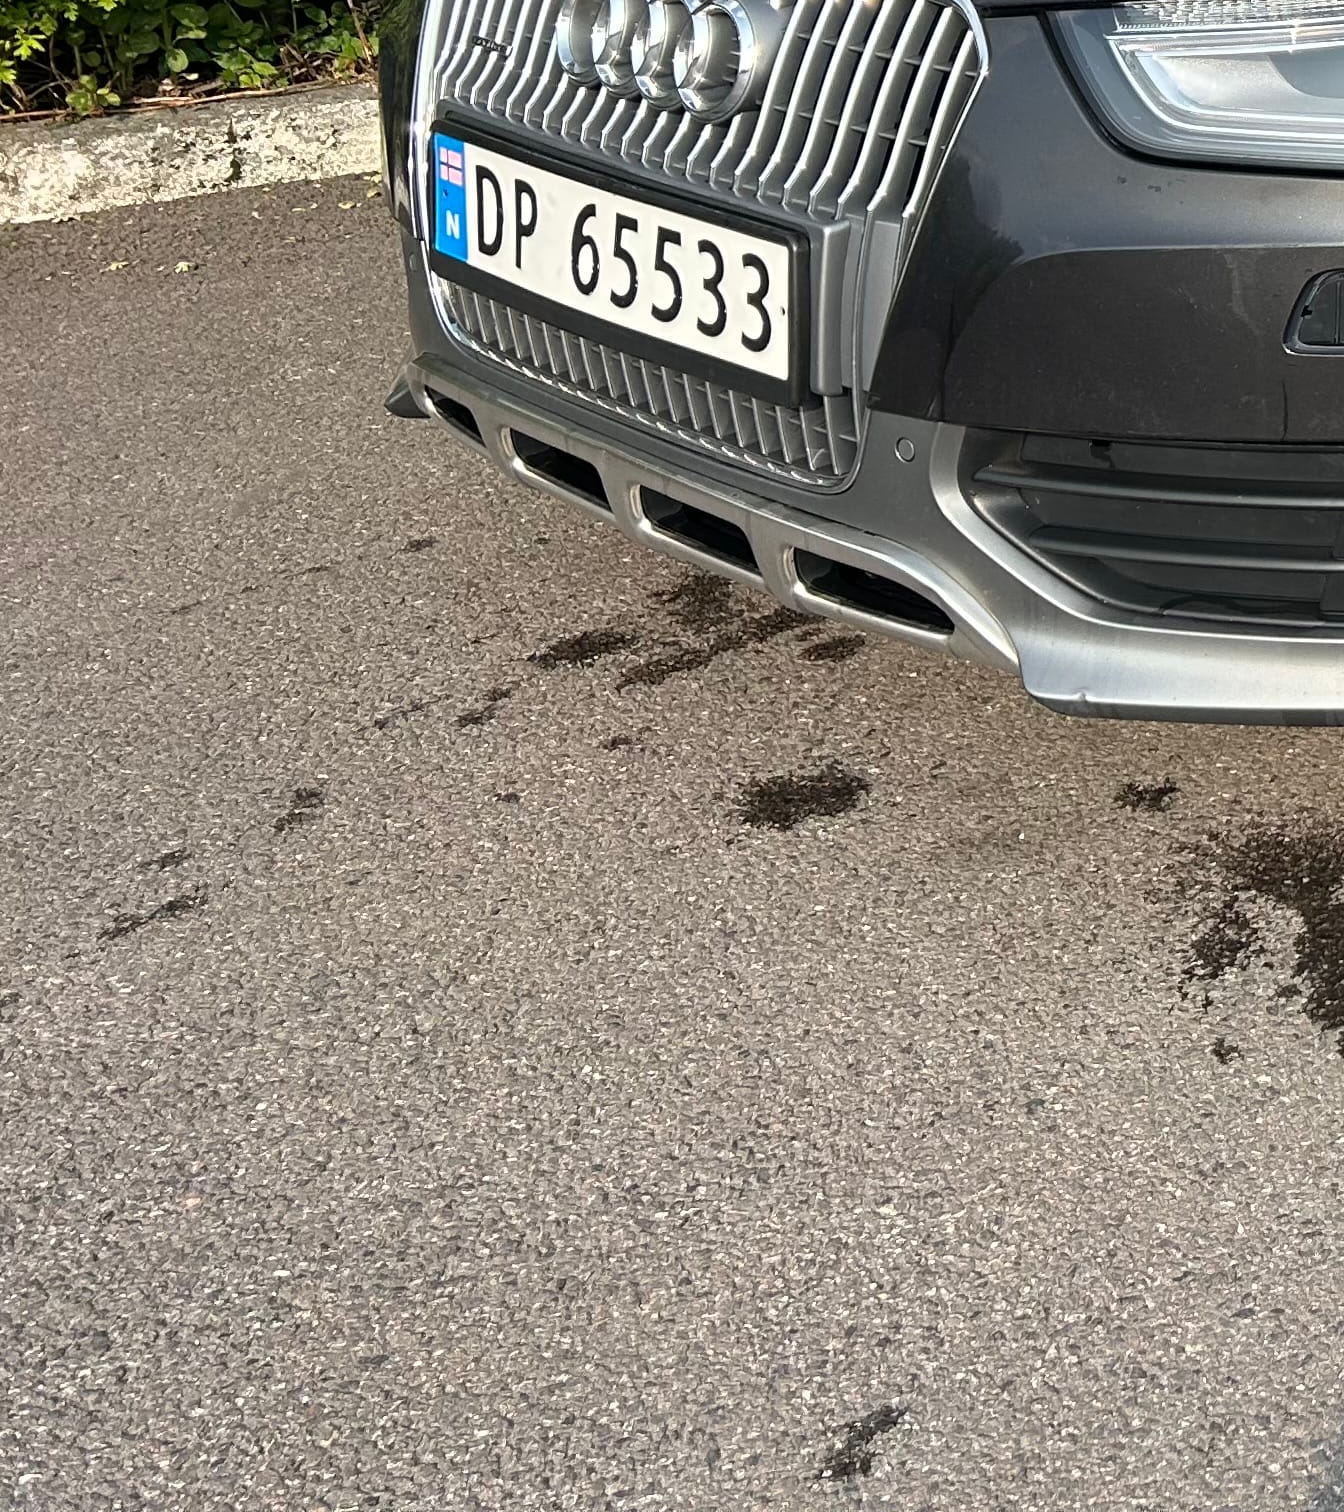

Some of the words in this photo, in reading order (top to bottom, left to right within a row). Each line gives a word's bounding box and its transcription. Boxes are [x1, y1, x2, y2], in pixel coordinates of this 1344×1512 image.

[446, 209, 461, 240] N
[475, 164, 538, 270] DP
[571, 203, 772, 353] 65533
